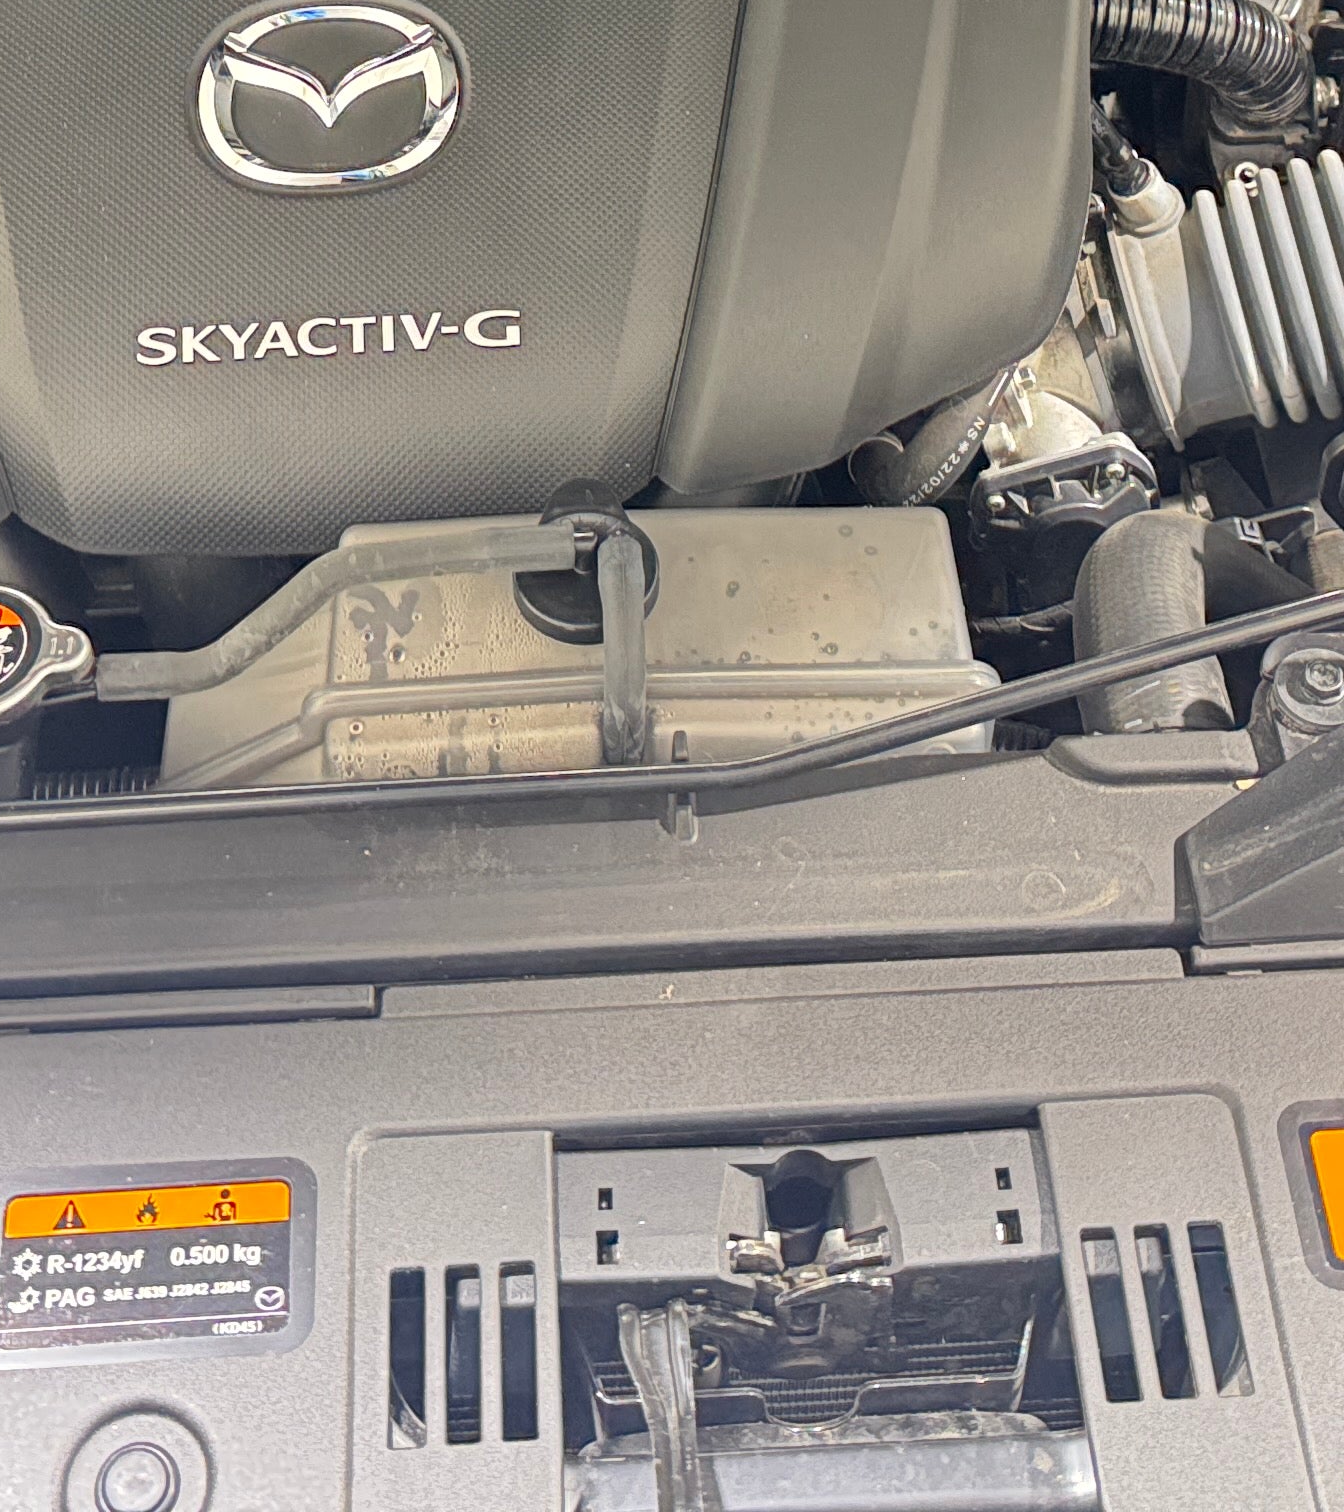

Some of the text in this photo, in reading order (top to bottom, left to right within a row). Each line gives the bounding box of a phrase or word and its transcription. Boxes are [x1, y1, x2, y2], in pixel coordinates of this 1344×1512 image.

[135, 308, 522, 366] SKYACTIV-G
[49, 636, 75, 655] 1.1
[47, 1243, 262, 1274] R-1234yf 0.500 kg
[44, 1287, 96, 1309] PAG
[102, 1287, 134, 1302] SAE
